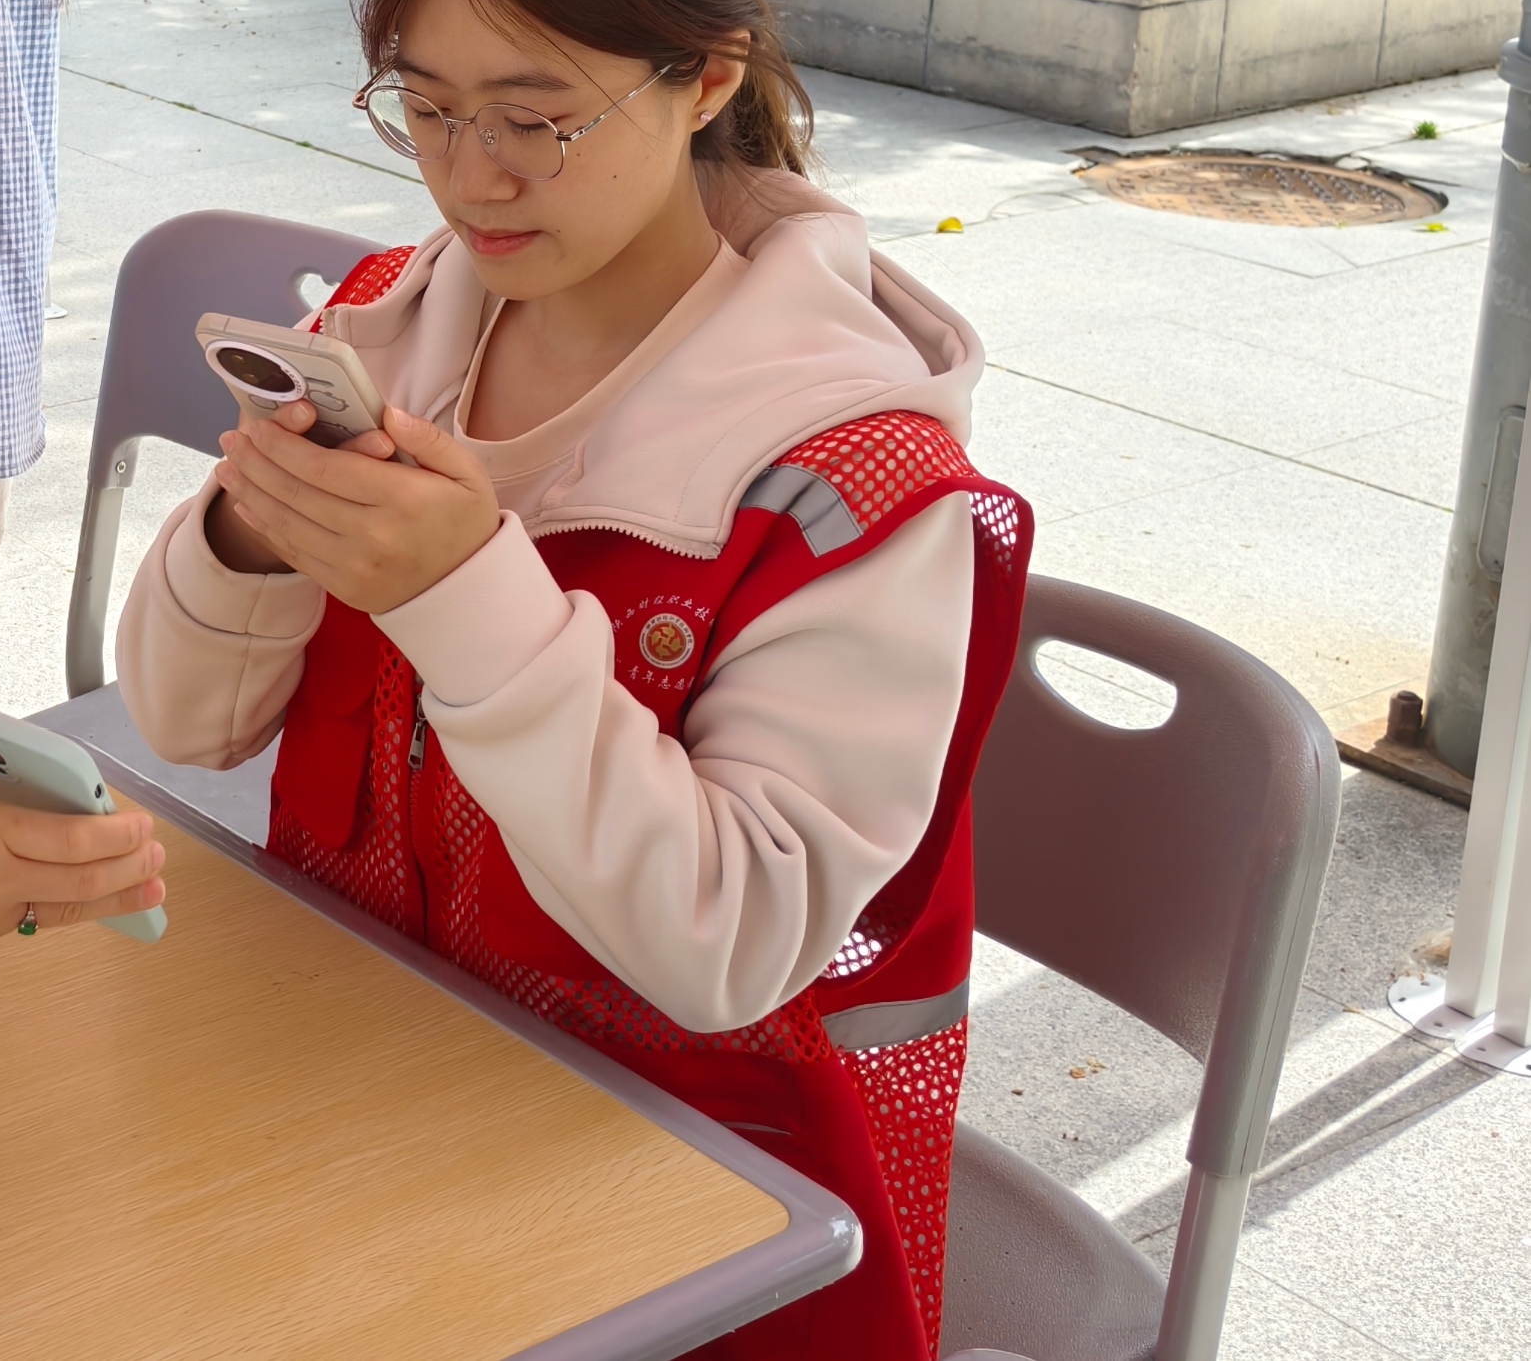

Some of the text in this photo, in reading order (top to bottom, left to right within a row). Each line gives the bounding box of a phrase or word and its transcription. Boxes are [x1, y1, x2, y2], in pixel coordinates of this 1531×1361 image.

[611, 595, 715, 633] 陕西财经职业技
[628, 665, 695, 691] 青年志愿
